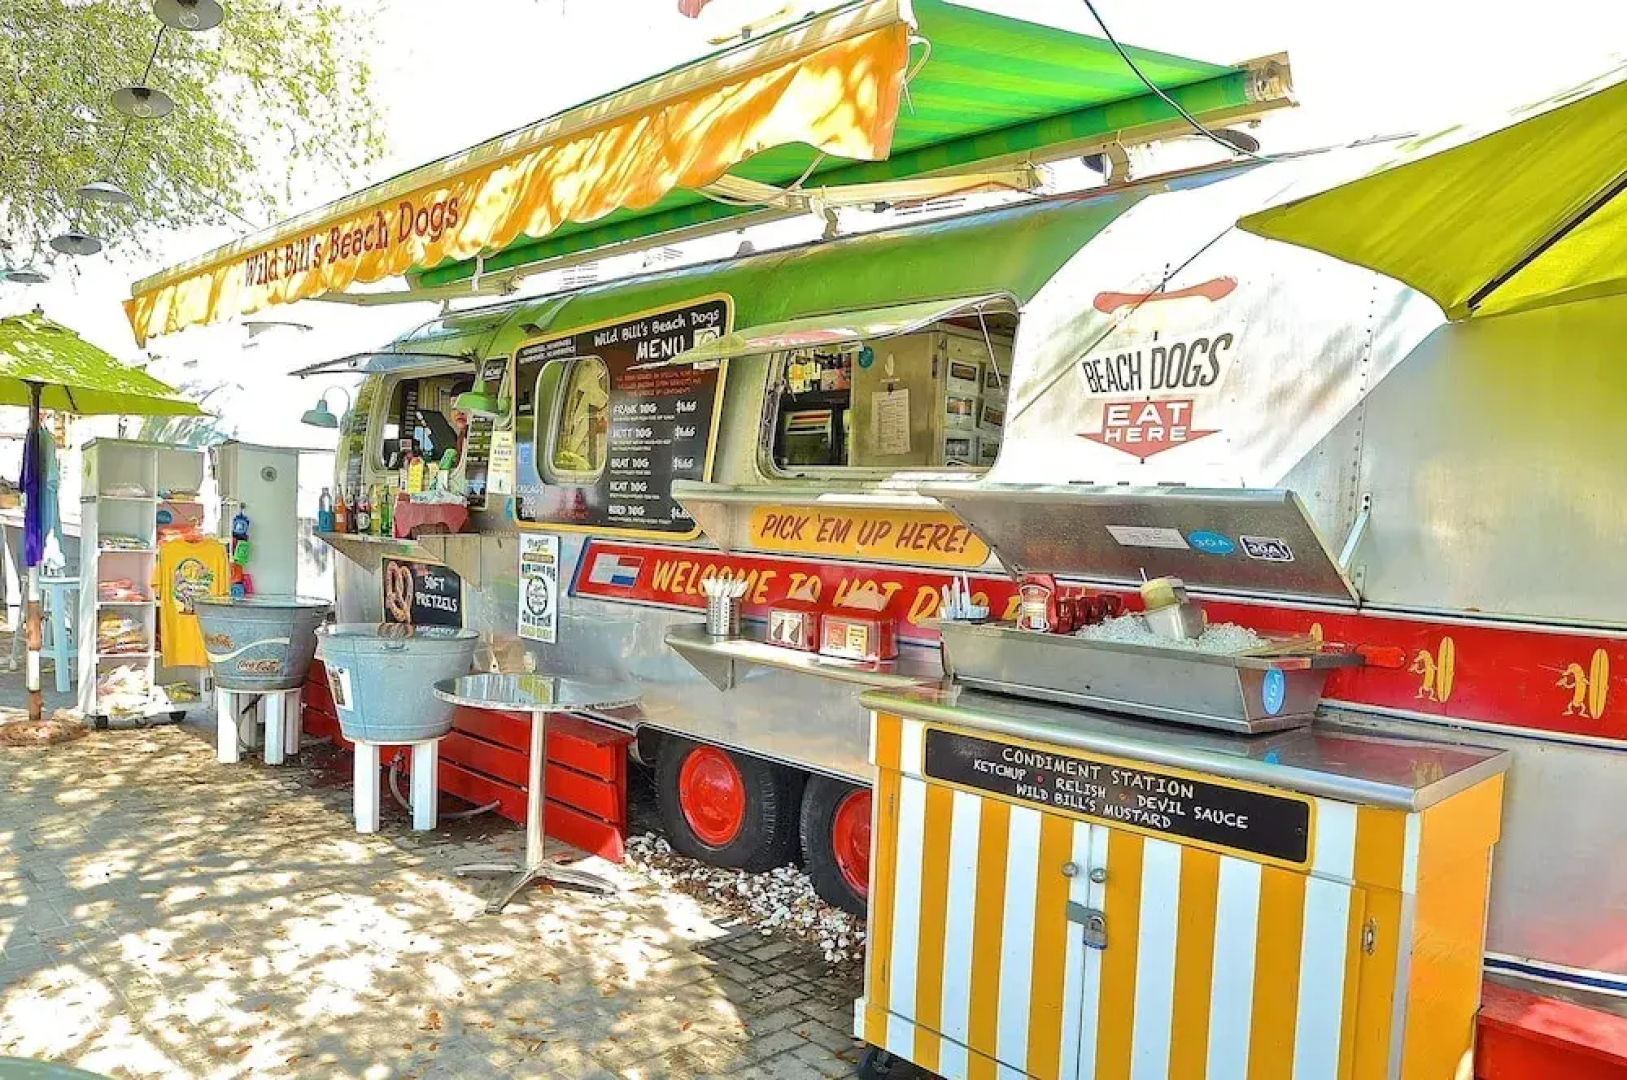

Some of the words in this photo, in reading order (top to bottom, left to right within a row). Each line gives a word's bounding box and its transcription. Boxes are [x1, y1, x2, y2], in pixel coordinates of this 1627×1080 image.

[244, 250, 278, 287] Wild
[285, 237, 321, 276] Bill's
[328, 209, 388, 265] Beach
[398, 197, 459, 243] Dogs
[594, 327, 619, 347] Wild
[622, 322, 648, 341] Bill's
[652, 314, 686, 334] Beach
[690, 308, 720, 328] Dogs
[635, 334, 685, 362] MENU
[1082, 351, 1142, 393] BEACH
[1150, 332, 1234, 390] DOGS
[1104, 425, 1188, 443] HERE
[1107, 402, 1190, 427] EAT
[760, 513, 810, 541] PICK
[815, 513, 853, 544] 'EM
[857, 520, 892, 546] UP
[896, 522, 971, 554] HERE!
[415, 591, 458, 613] PRETZELS
[425, 576, 445, 592] SOFT
[1001, 748, 1102, 780] CONDIMENT
[1110, 769, 1195, 800] STATION
[972, 759, 1027, 781] KETCHUP
[1055, 778, 1106, 799] RELISH
[1136, 794, 1186, 816] DEVIL
[1193, 806, 1250, 830] SAUCE
[1016, 783, 1049, 802] WILD
[1053, 793, 1096, 812] BILL'S
[1103, 804, 1172, 829] MUSTARD
